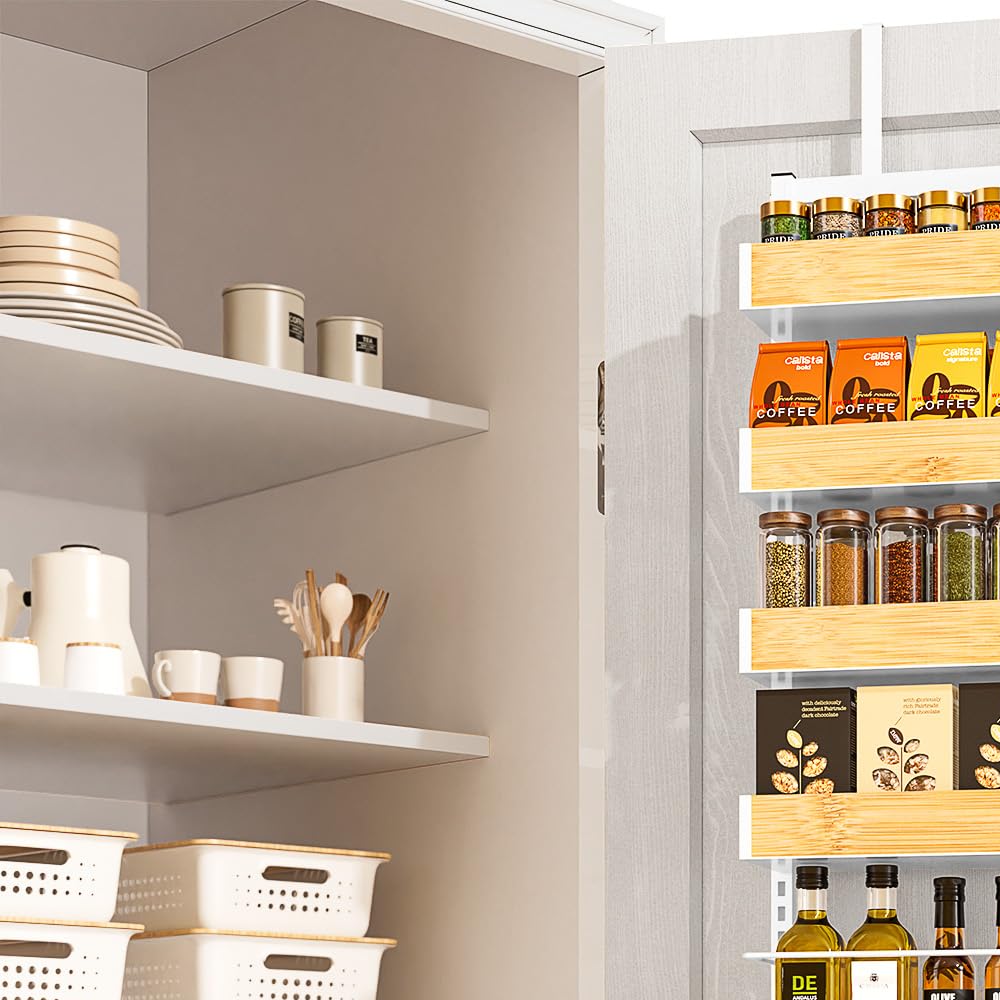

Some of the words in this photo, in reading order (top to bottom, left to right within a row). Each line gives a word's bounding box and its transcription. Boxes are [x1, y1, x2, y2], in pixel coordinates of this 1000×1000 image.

[765, 235, 794, 243] PRIDE
[817, 232, 846, 240] PRIDE
[869, 229, 898, 237] PRIDE
[835, 403, 895, 415] COFFEE
[915, 399, 976, 411] COFFEE
[757, 406, 816, 419] COFFEE
[792, 975, 817, 991] DE
